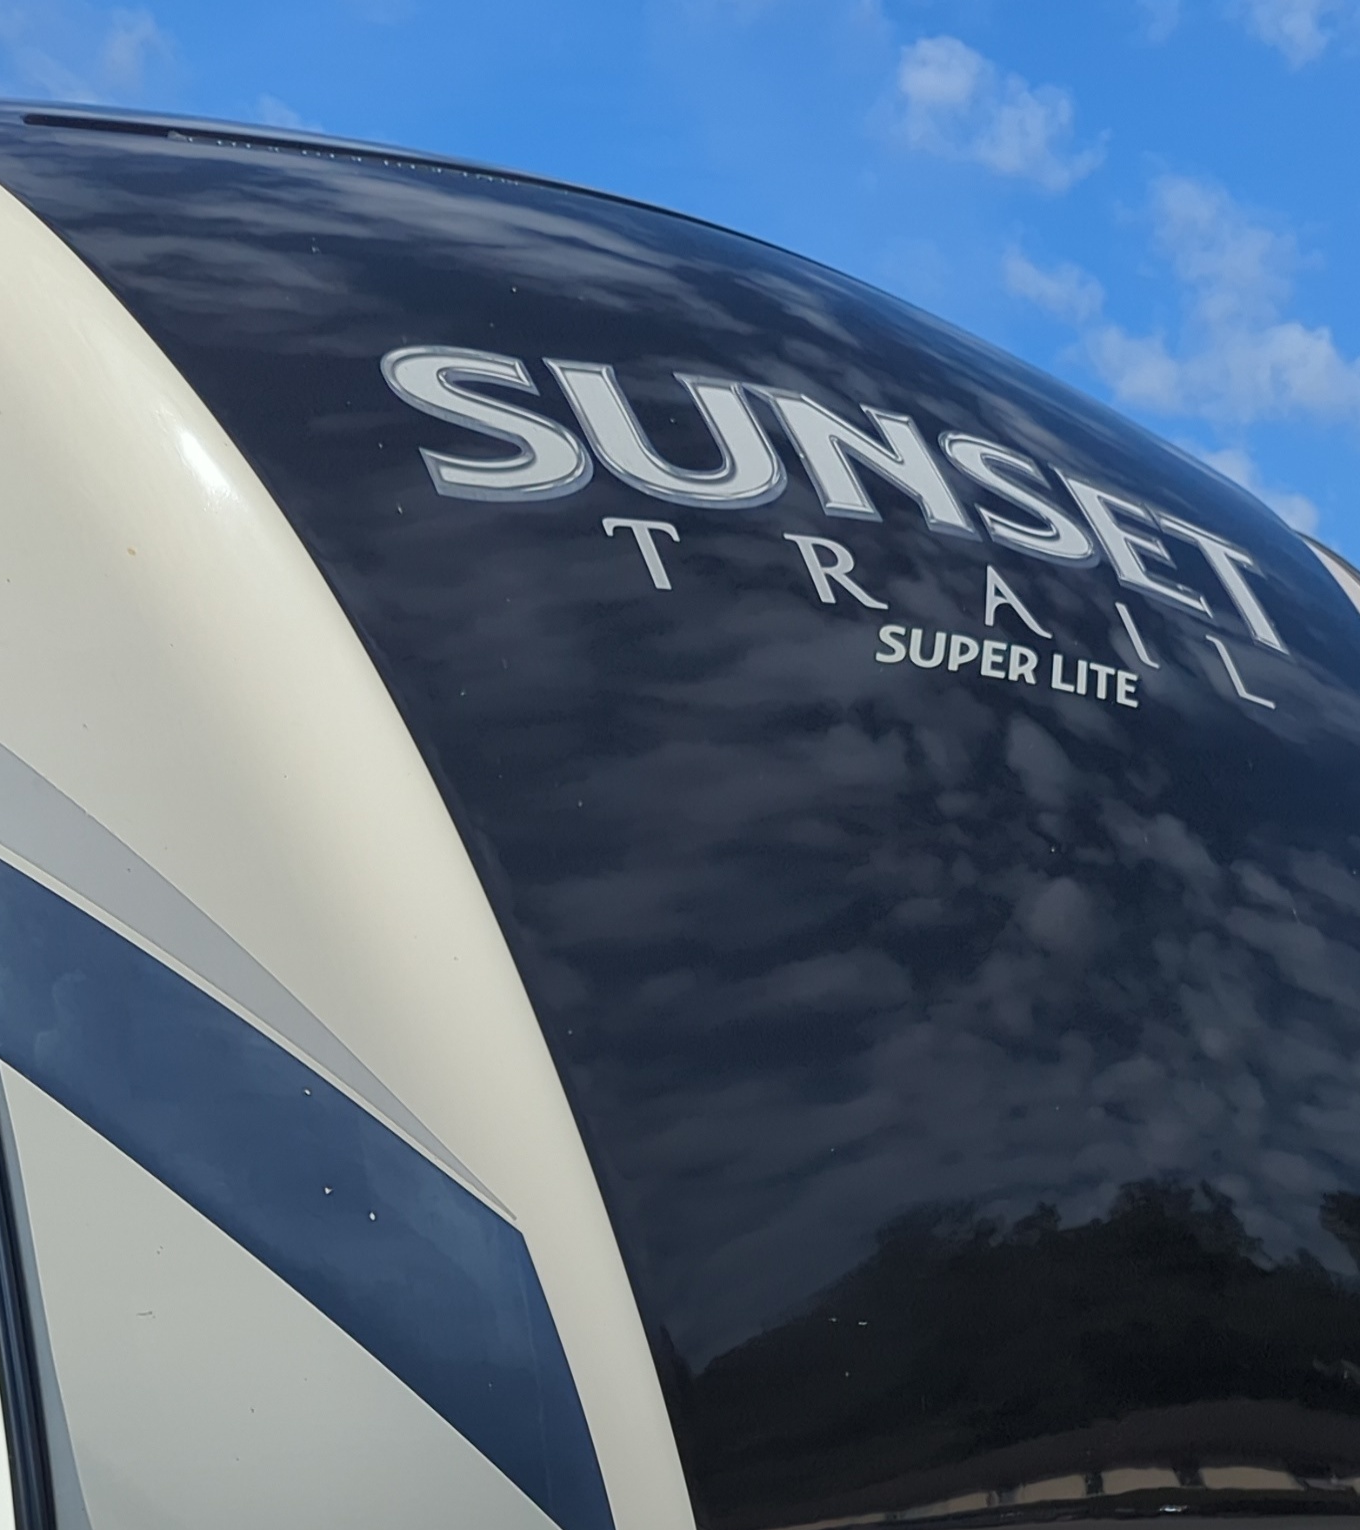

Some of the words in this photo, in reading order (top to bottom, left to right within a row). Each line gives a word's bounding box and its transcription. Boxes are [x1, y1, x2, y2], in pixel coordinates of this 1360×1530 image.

[378, 345, 1292, 656] SUNSET
[601, 516, 1277, 709] TRAIL
[875, 624, 1038, 687] SUPER
[1051, 651, 1141, 709] LITE
